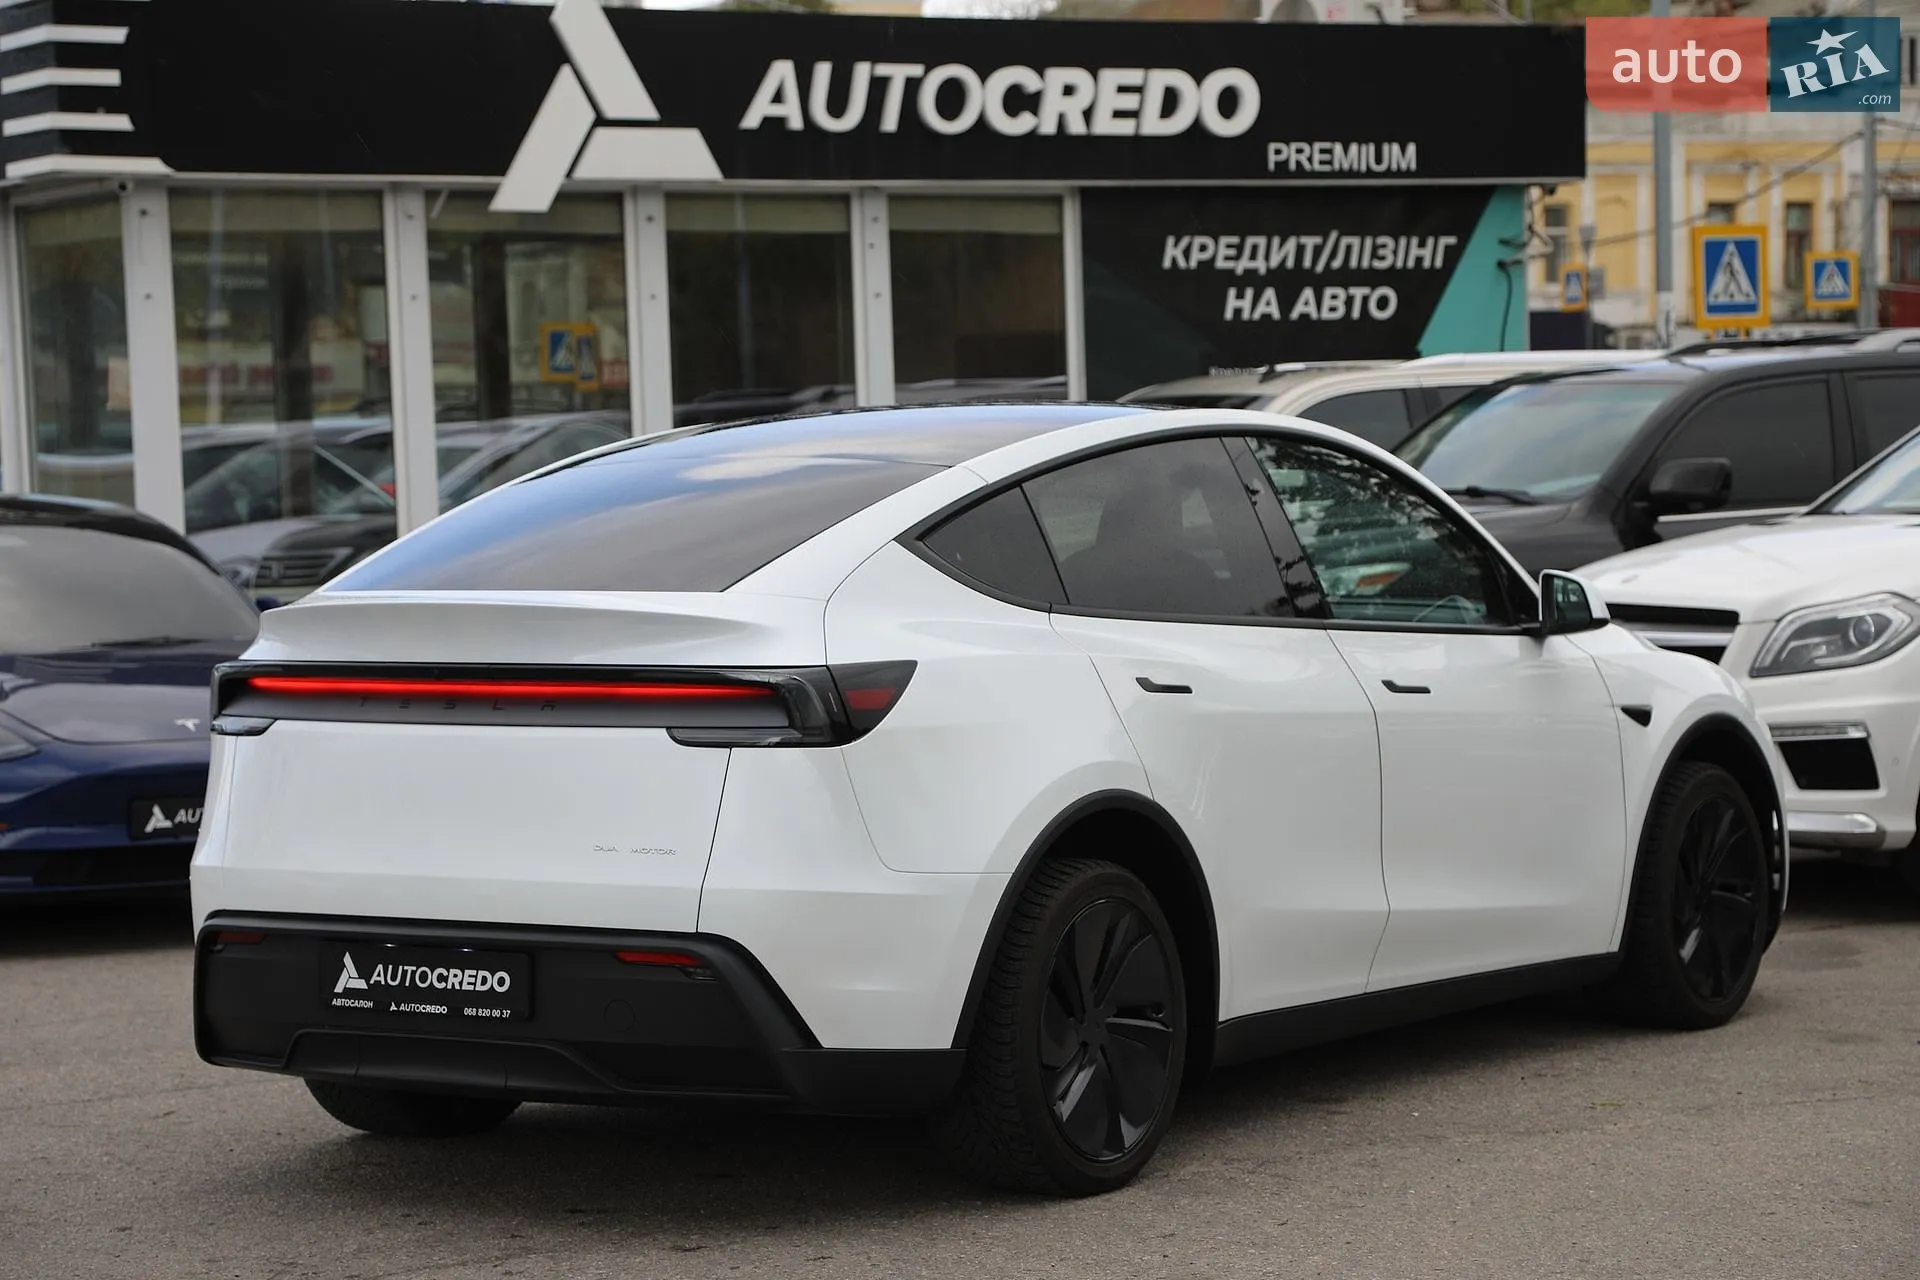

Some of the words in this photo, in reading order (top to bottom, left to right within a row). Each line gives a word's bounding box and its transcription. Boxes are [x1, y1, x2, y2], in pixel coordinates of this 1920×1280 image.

[739, 59, 1260, 137] AUTOCREDO
[1267, 142, 1417, 173] PREMIUM
[1162, 230, 1458, 275] КРЕДИТ/ЛІЗІНГ
[1223, 286, 1281, 321] НА
[1289, 286, 1398, 320] АВТО
[360, 697, 556, 711] TESLA
[631, 847, 677, 856] MOTOR
[370, 964, 511, 993] AUTOCREDO
[332, 998, 374, 1009] АВТОСАЛОН
[399, 1003, 448, 1015] AUTOCREDO
[477, 1008, 491, 1017] 820
[491, 1009, 501, 1018] 00
[502, 1009, 511, 1018] 37
